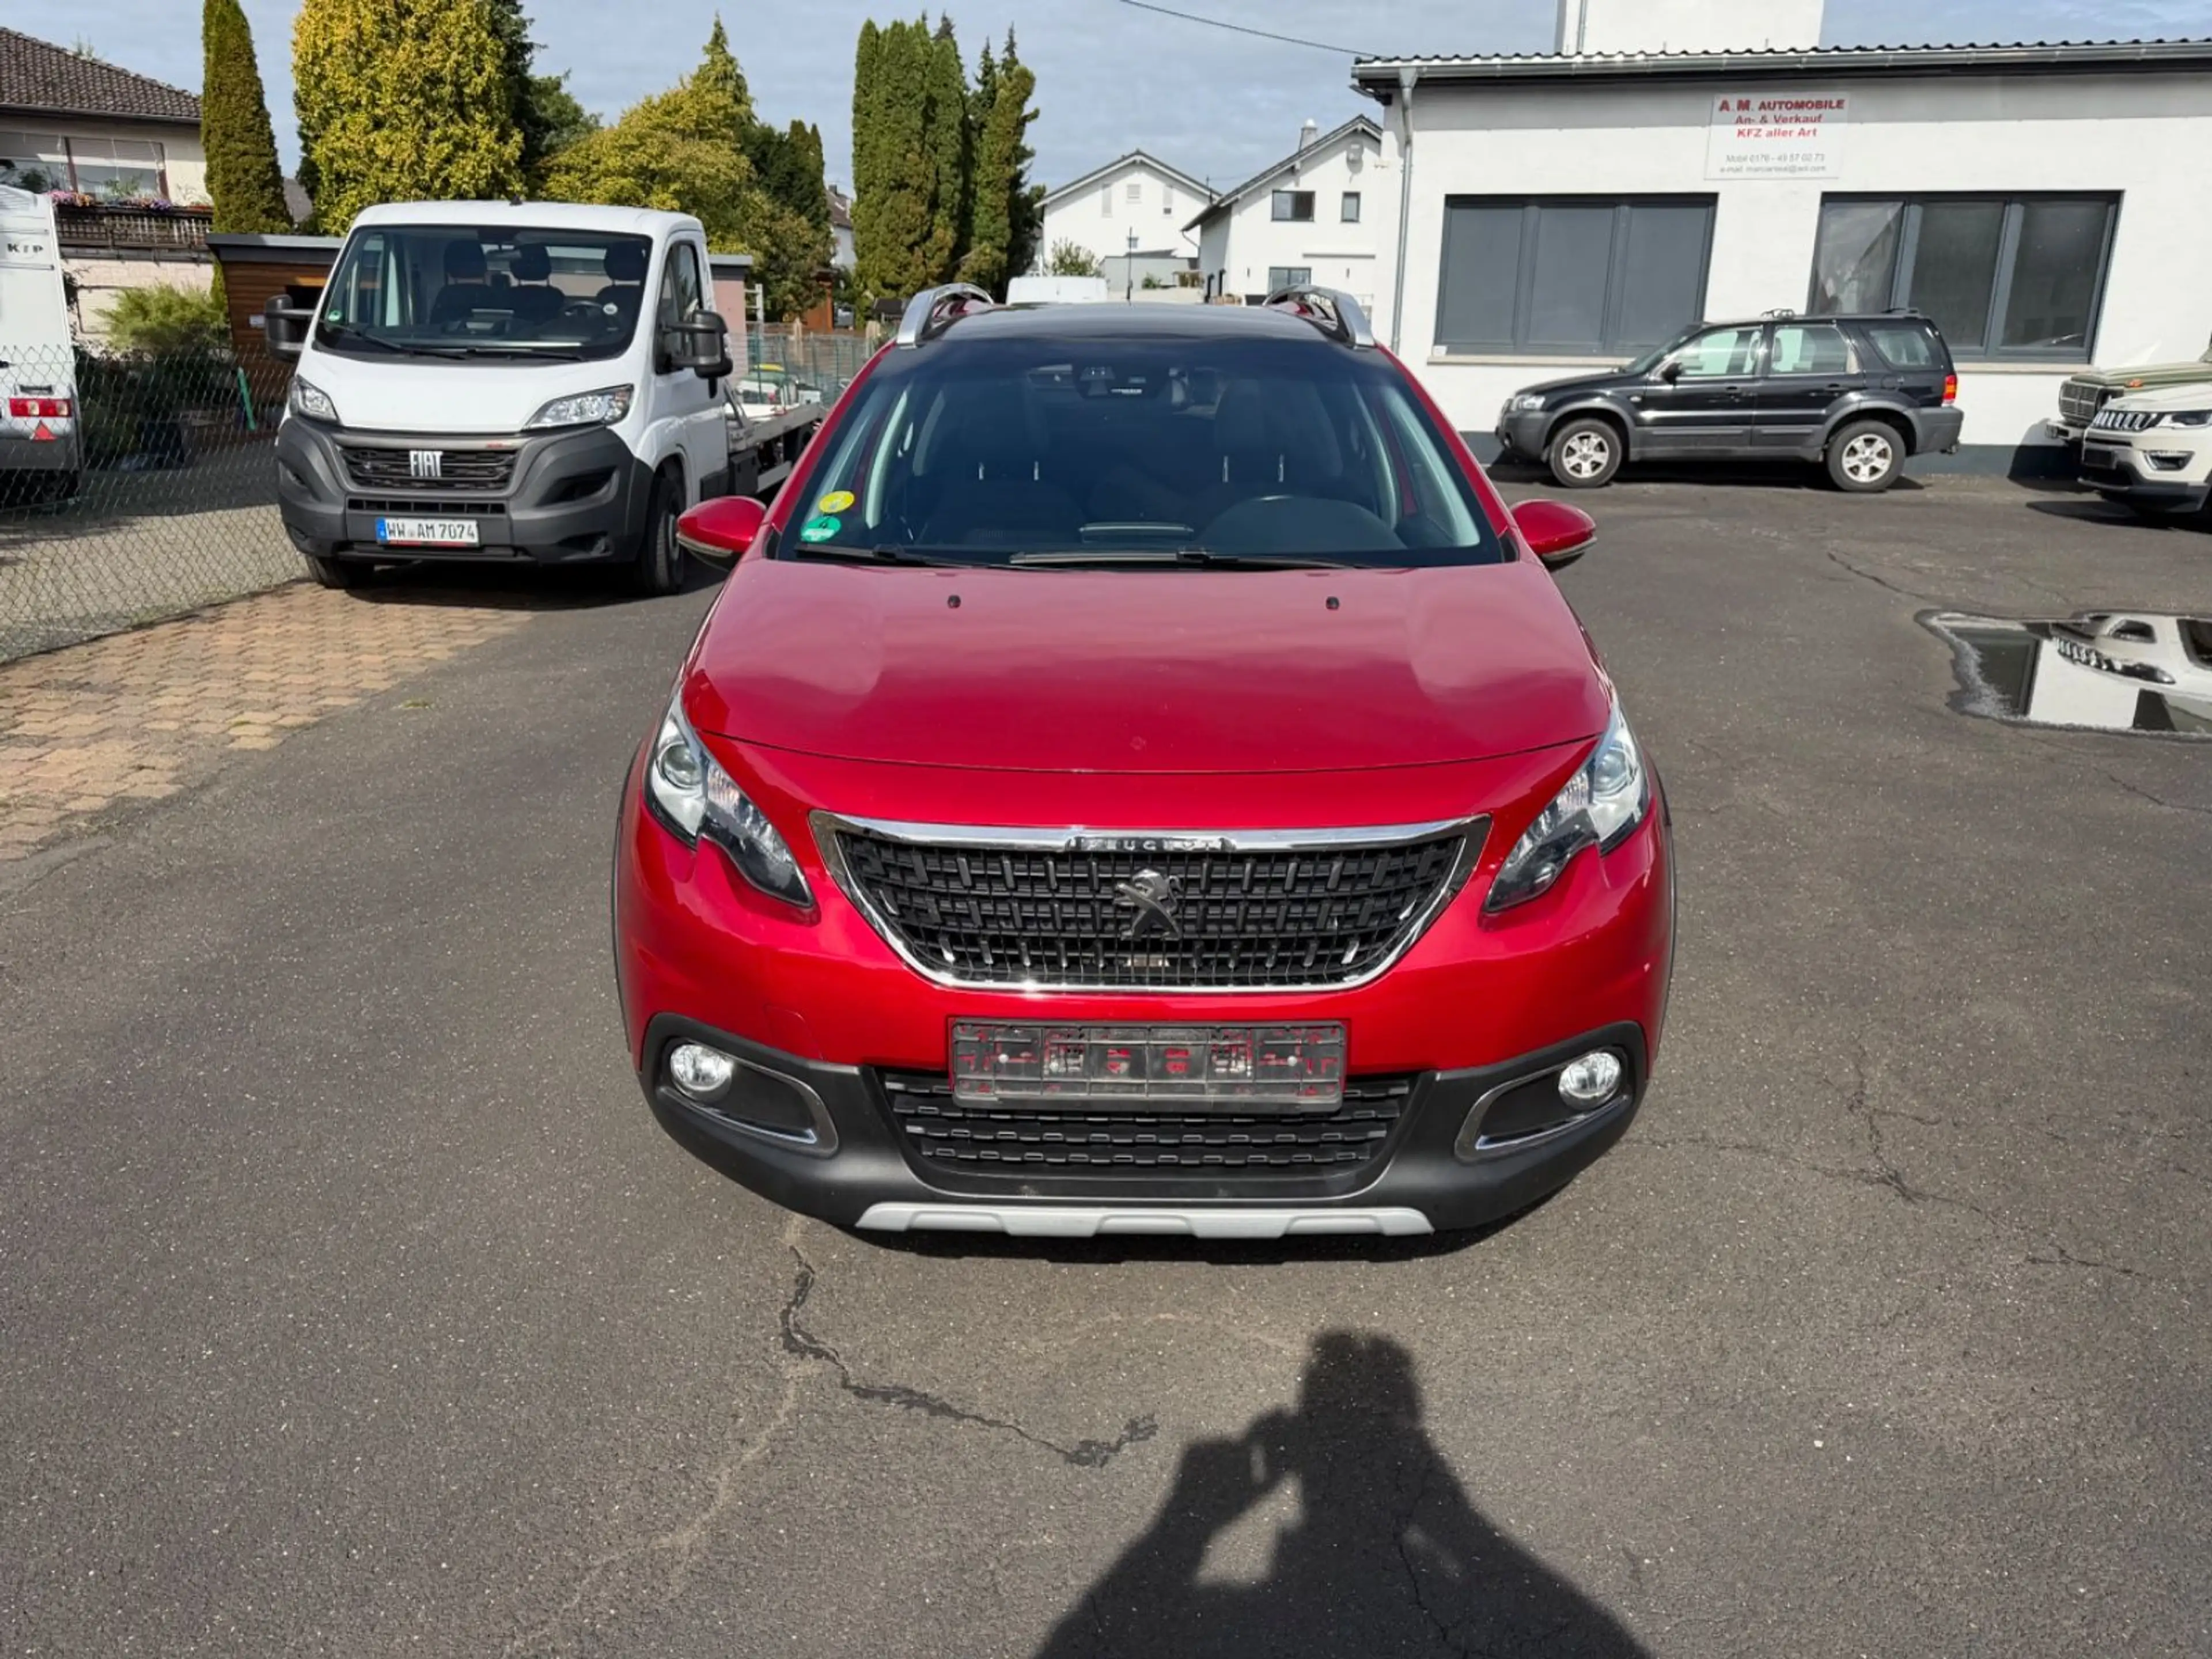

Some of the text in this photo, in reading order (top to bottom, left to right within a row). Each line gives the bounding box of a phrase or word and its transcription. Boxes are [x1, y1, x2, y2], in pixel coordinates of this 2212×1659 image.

[1759, 99, 1845, 110] AUTOMOBILE
[1760, 115, 1768, 124] &
[1774, 114, 1823, 123] Verkauf
[1737, 127, 1817, 138] KFZ aller Art
[410, 450, 443, 477] FIAT
[417, 523, 435, 539] AM
[438, 524, 475, 539] 7074
